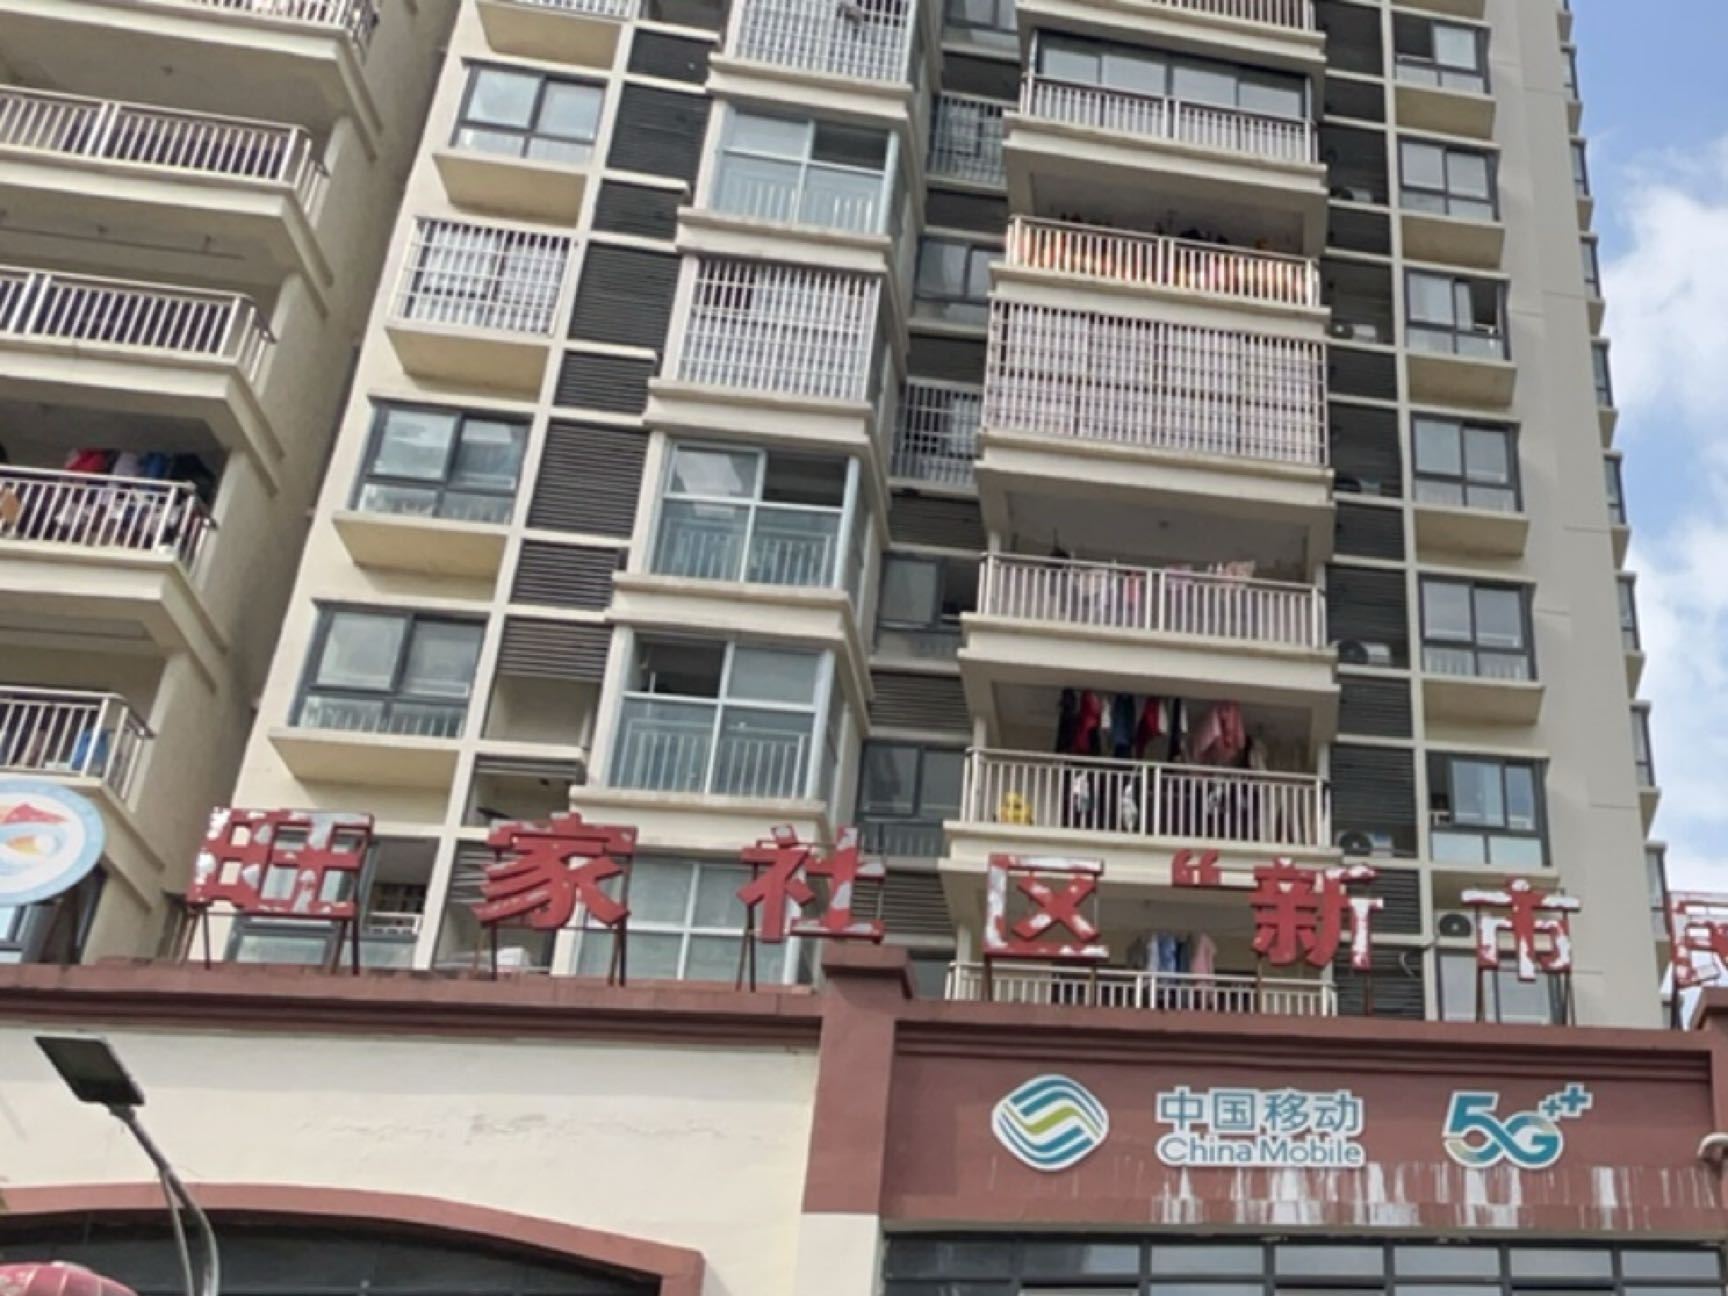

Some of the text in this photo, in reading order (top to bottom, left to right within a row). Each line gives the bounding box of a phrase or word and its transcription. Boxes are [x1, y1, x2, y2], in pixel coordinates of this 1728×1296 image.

[1156, 1086, 1366, 1134] 中国移动
[1156, 1133, 1366, 1167] China Mobile
